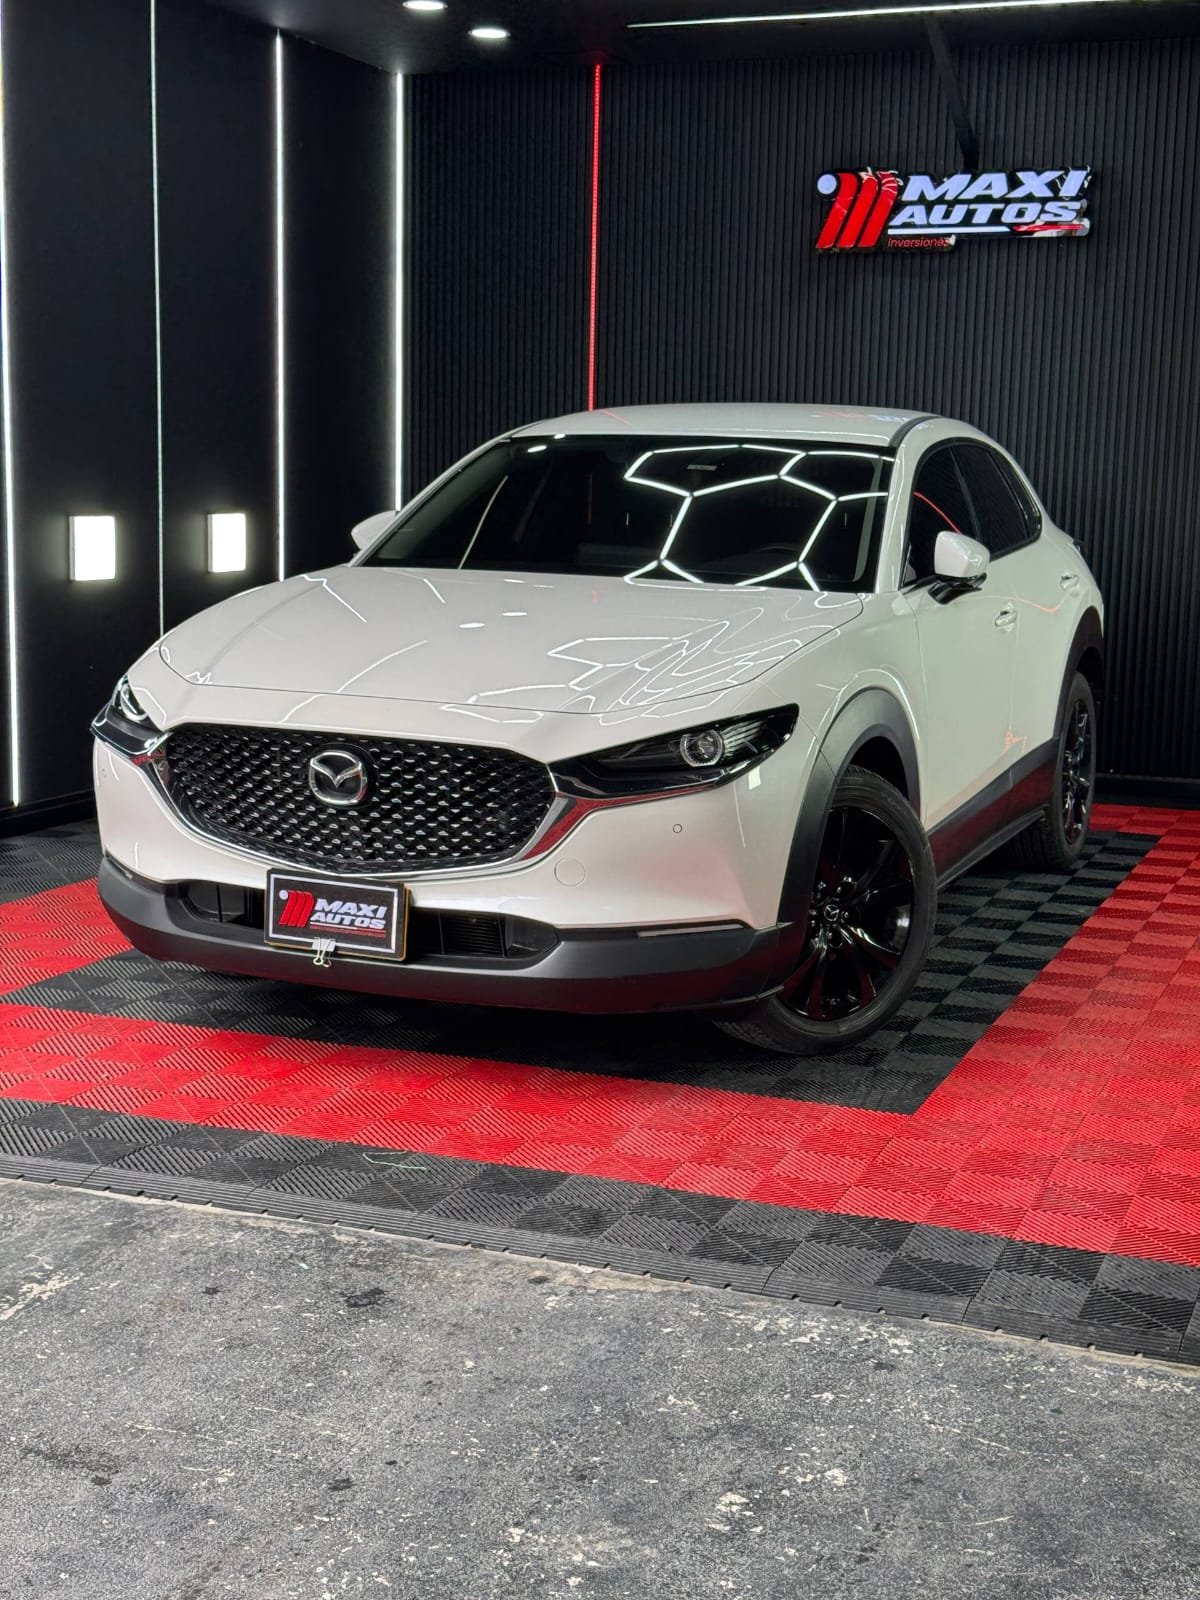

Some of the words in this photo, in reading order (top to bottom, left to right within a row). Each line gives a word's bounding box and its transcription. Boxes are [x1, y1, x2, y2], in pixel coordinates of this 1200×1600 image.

[901, 170, 1088, 201] MAXI
[889, 201, 1082, 226] AUTOS
[315, 898, 389, 919] MAXI
[310, 912, 387, 930] AUTOS
